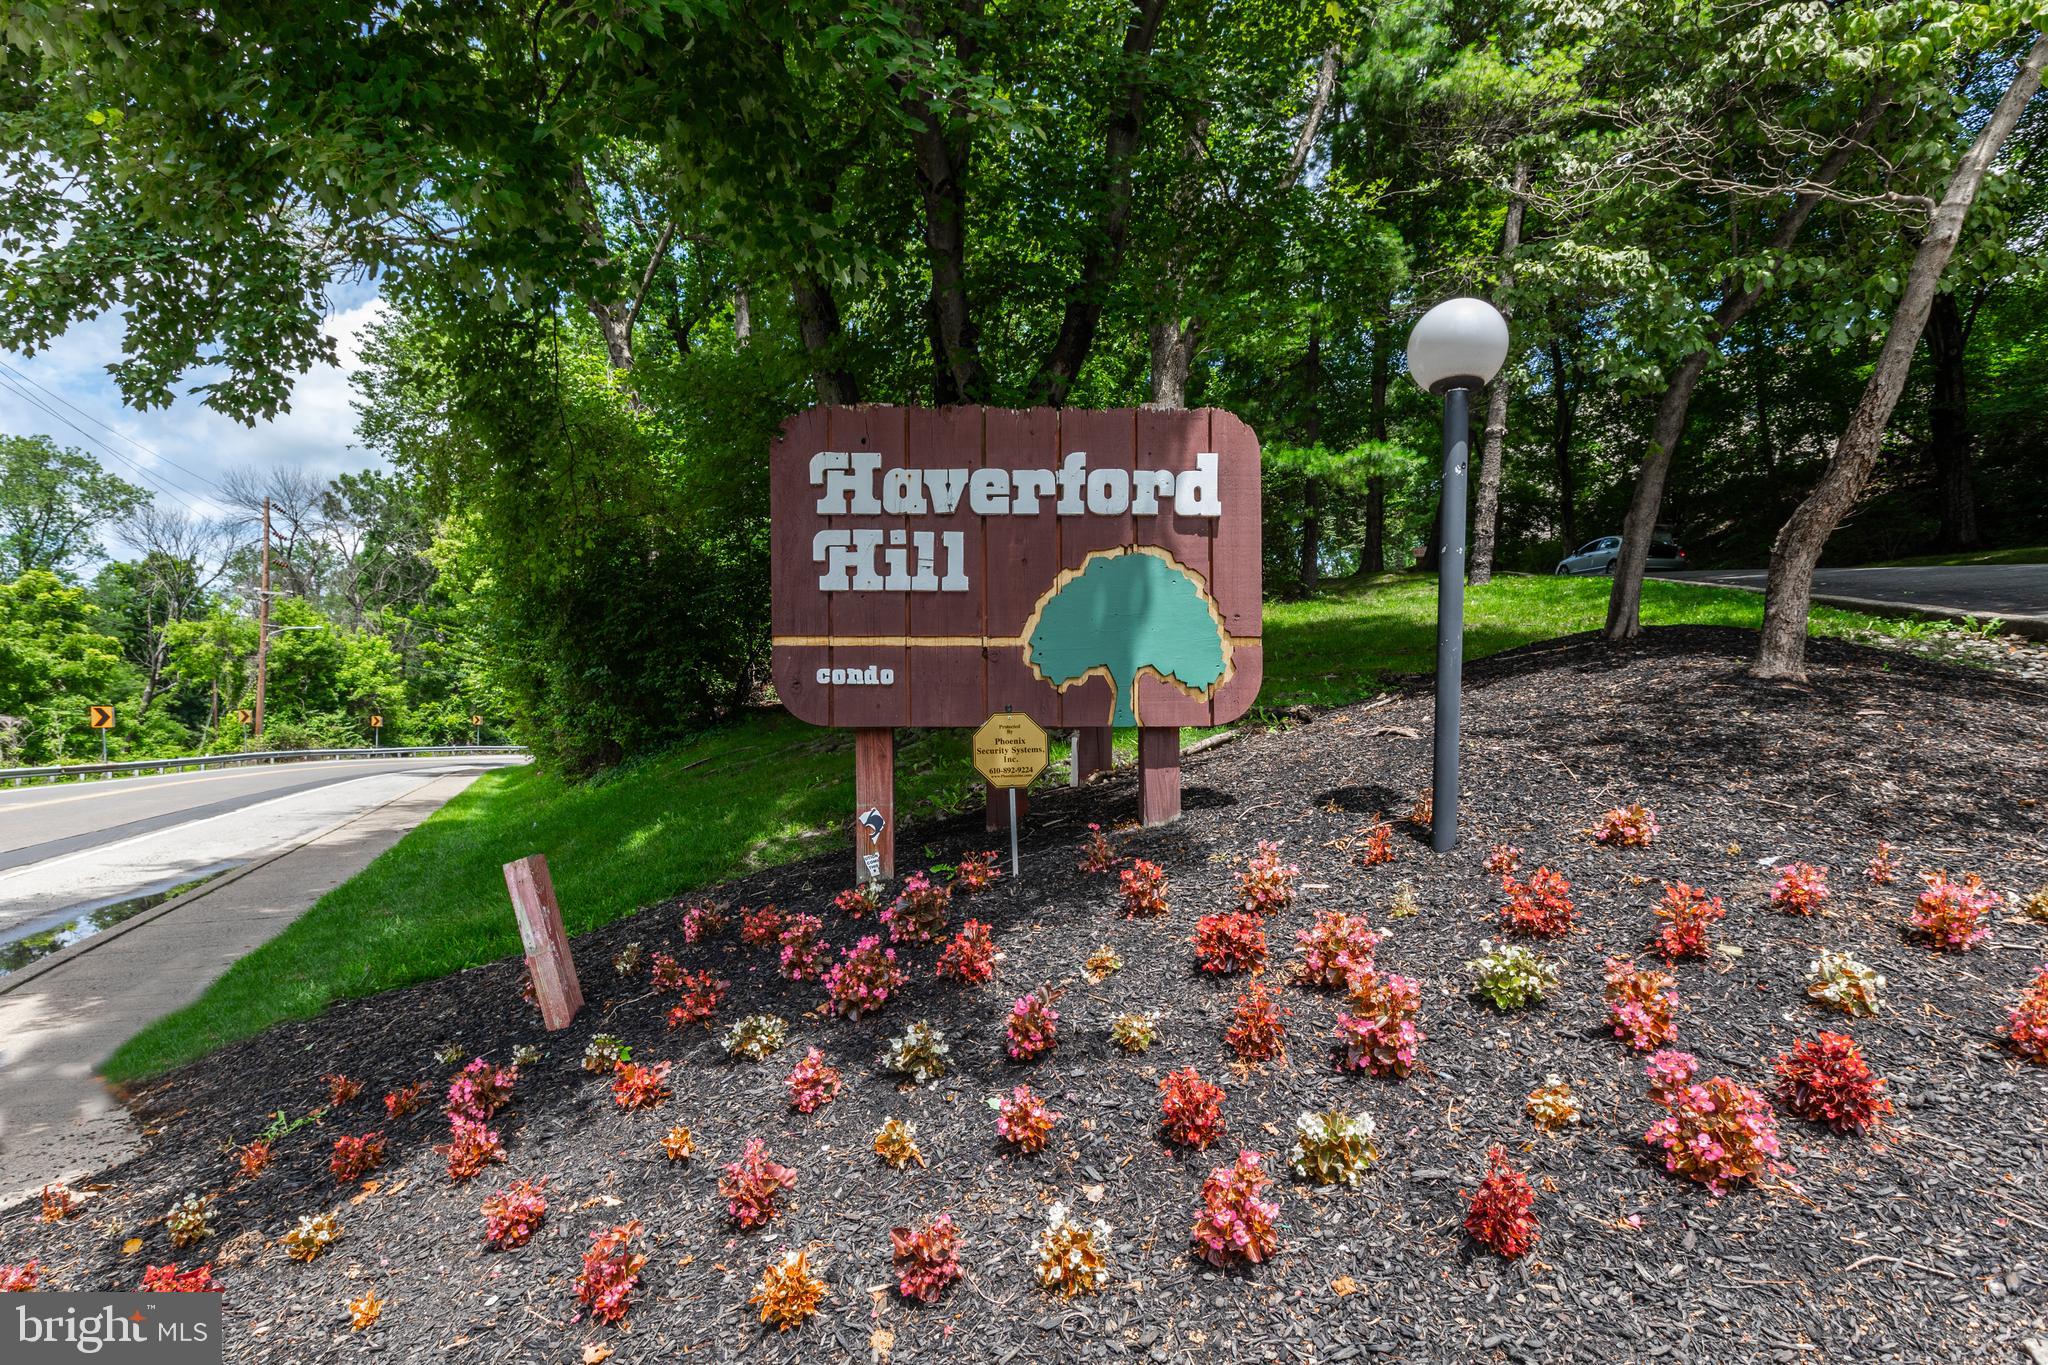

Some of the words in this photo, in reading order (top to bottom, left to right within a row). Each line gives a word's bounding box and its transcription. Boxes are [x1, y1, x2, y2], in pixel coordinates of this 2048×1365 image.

[809, 451, 1221, 516] Haverford
[813, 529, 969, 591] Hill
[816, 665, 894, 685] condo
[994, 737, 1026, 746] Phoenix
[976, 747, 1009, 756] Security
[989, 766, 1034, 775] 610-892-9224
